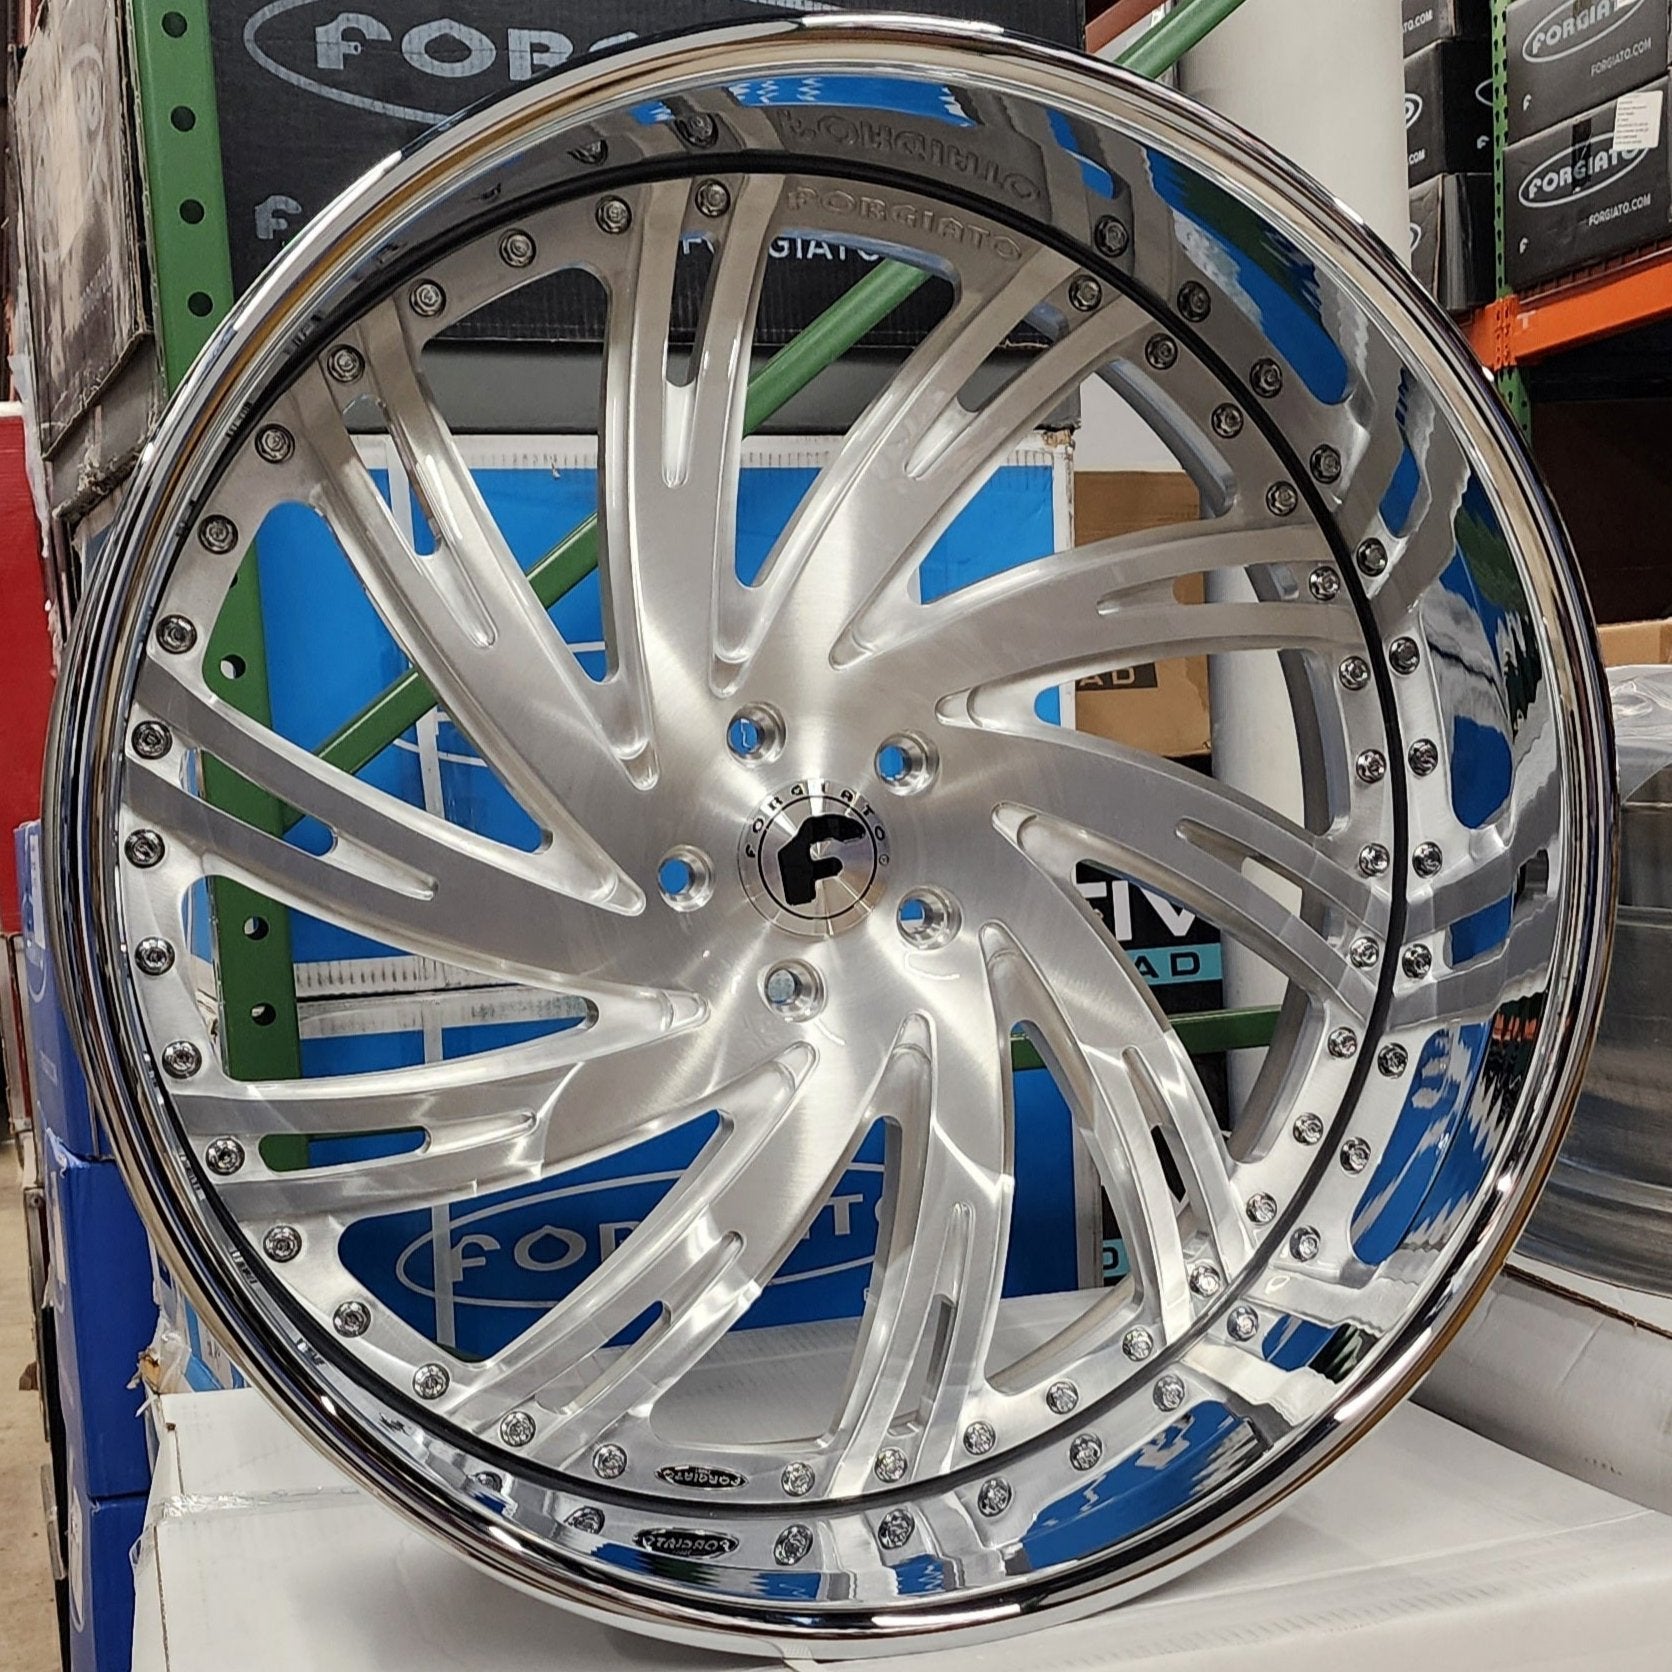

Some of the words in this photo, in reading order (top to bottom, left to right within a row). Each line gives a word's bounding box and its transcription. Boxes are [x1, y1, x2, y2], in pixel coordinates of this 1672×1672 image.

[1590, 37, 1652, 77] FORGIATO.COM
[788, 187, 1023, 260] FORGIATO
[1588, 193, 1652, 227] FORGIATO.COM
[745, 783, 886, 858] FORGIATO
